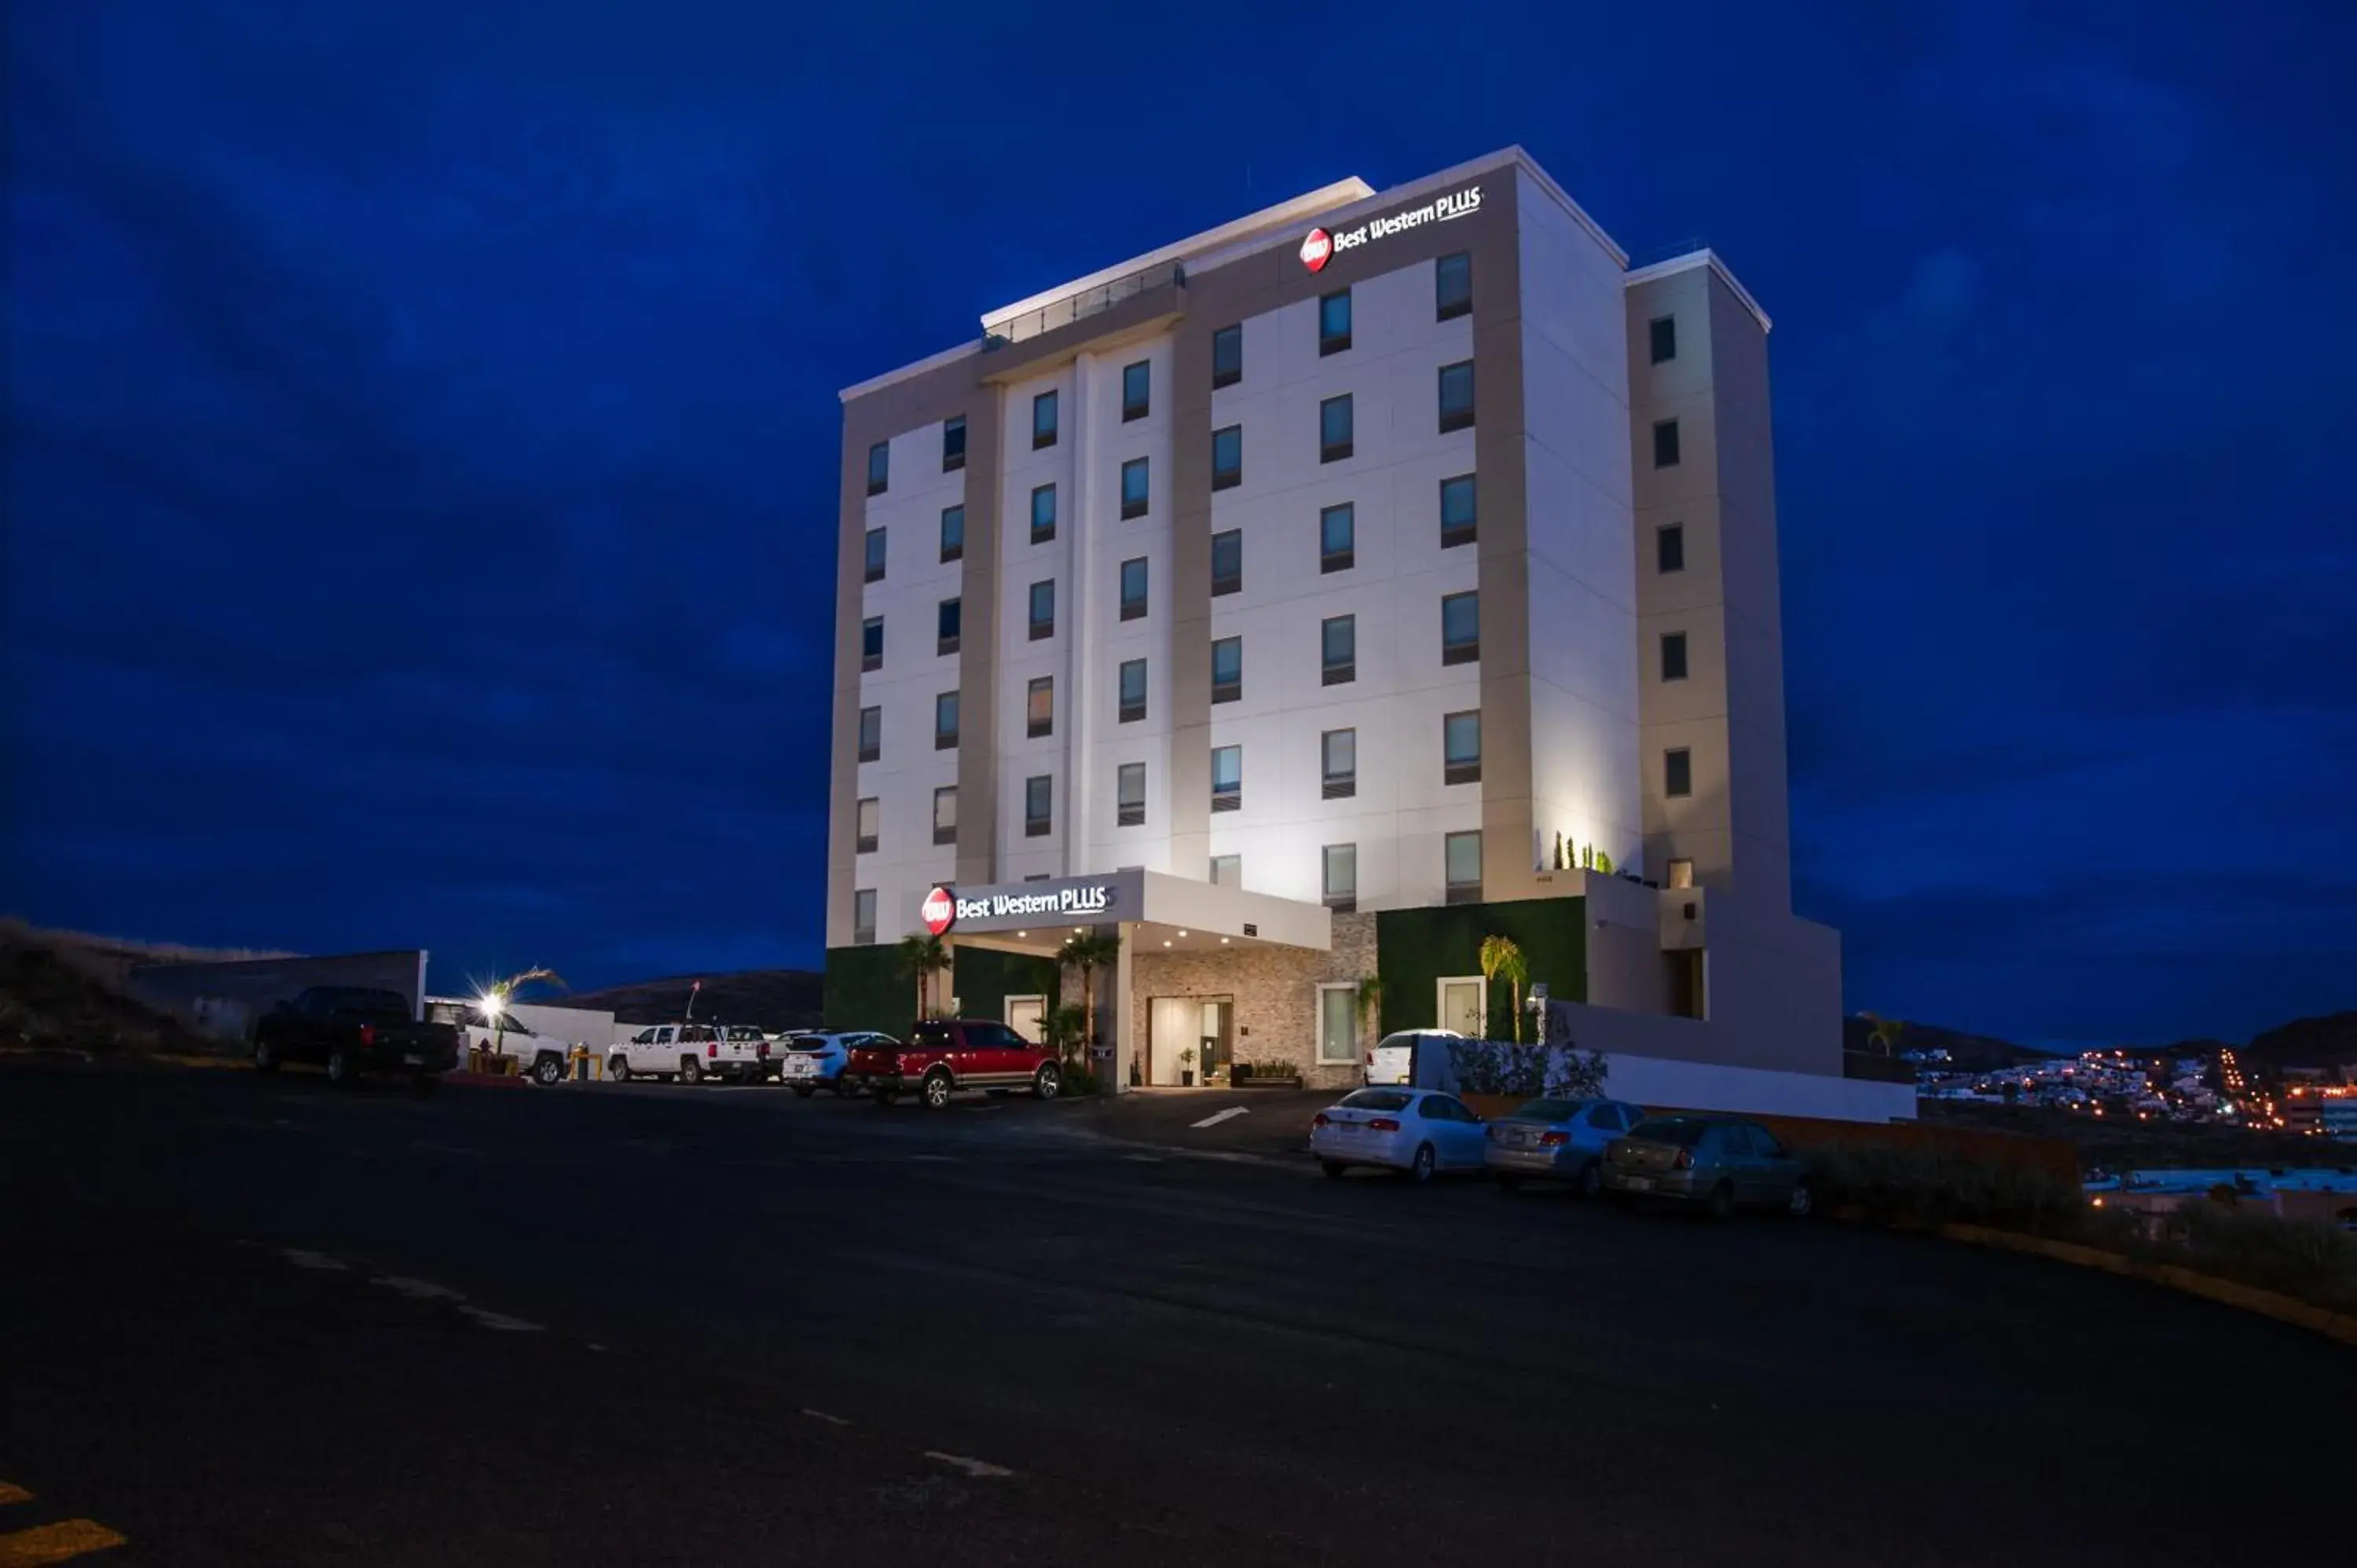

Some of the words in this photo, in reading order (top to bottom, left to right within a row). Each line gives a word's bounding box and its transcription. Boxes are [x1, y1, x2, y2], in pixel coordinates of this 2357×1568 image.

[1333, 226, 1367, 252] Best
[1369, 206, 1435, 239] Western
[1435, 187, 1481, 218] PLUS
[955, 899, 990, 918] Best
[994, 894, 1058, 916] Western
[1061, 887, 1105, 909] PLUS
